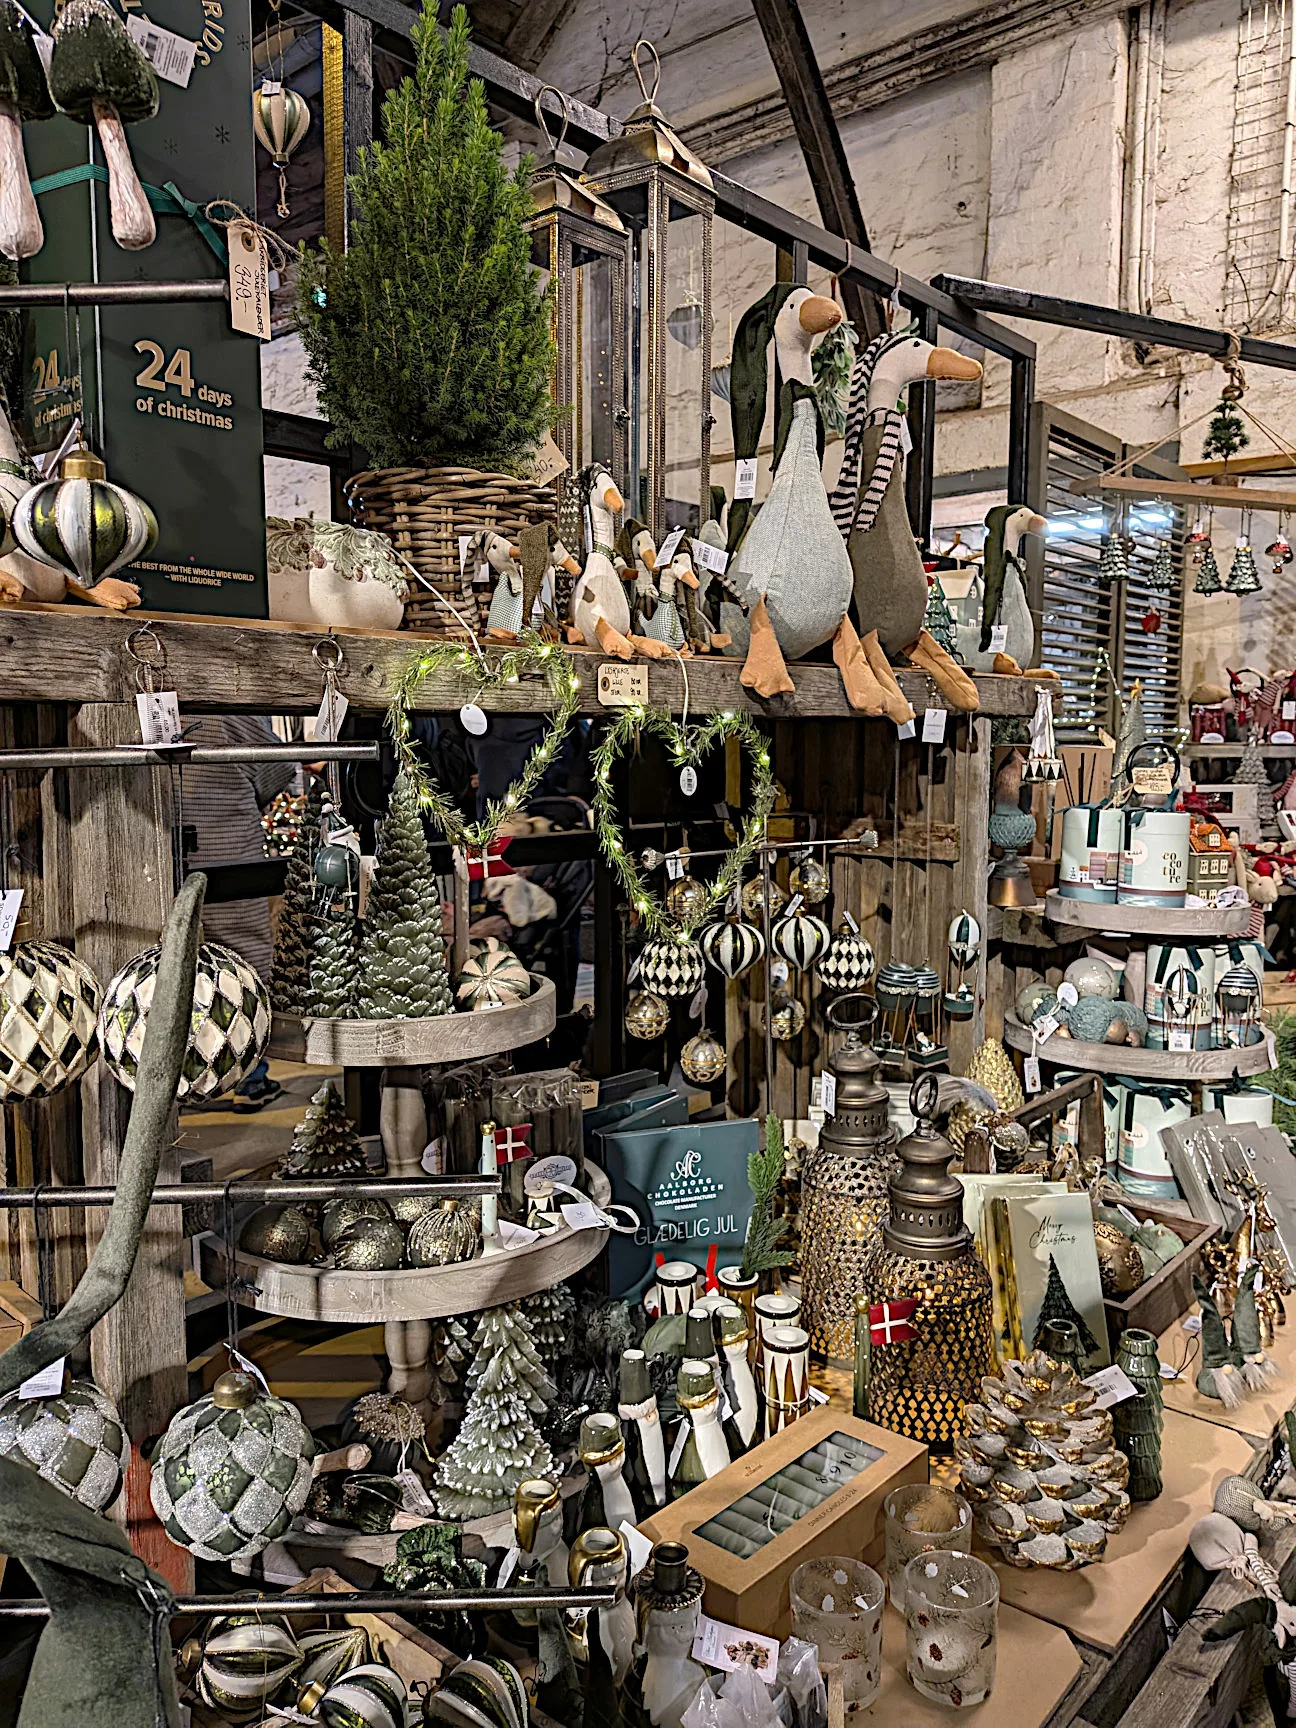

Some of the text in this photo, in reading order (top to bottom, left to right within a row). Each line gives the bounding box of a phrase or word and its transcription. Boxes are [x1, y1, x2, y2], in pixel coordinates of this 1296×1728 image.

[32, 349, 61, 405] 24
[135, 340, 233, 408] 24 days
[136, 396, 233, 430] of christmas
[141, 561, 159, 571] BEST
[159, 563, 179, 574] FROM
[179, 565, 193, 576] THE
[193, 567, 216, 578] WHOLE
[216, 570, 232, 580] WIDE
[232, 572, 254, 581] WORLD
[170, 573, 188, 584] WITH
[188, 575, 222, 588] LIQUORICE
[647, 1183, 724, 1200] CHOKOLADEN
[659, 1177, 712, 1191] AALBORG
[655, 1198, 681, 1207] CHOCOLATE
[674, 1202, 698, 1212] DENMARK
[634, 1218, 710, 1246] GLÆDELIG
[713, 1214, 739, 1235] JUL
